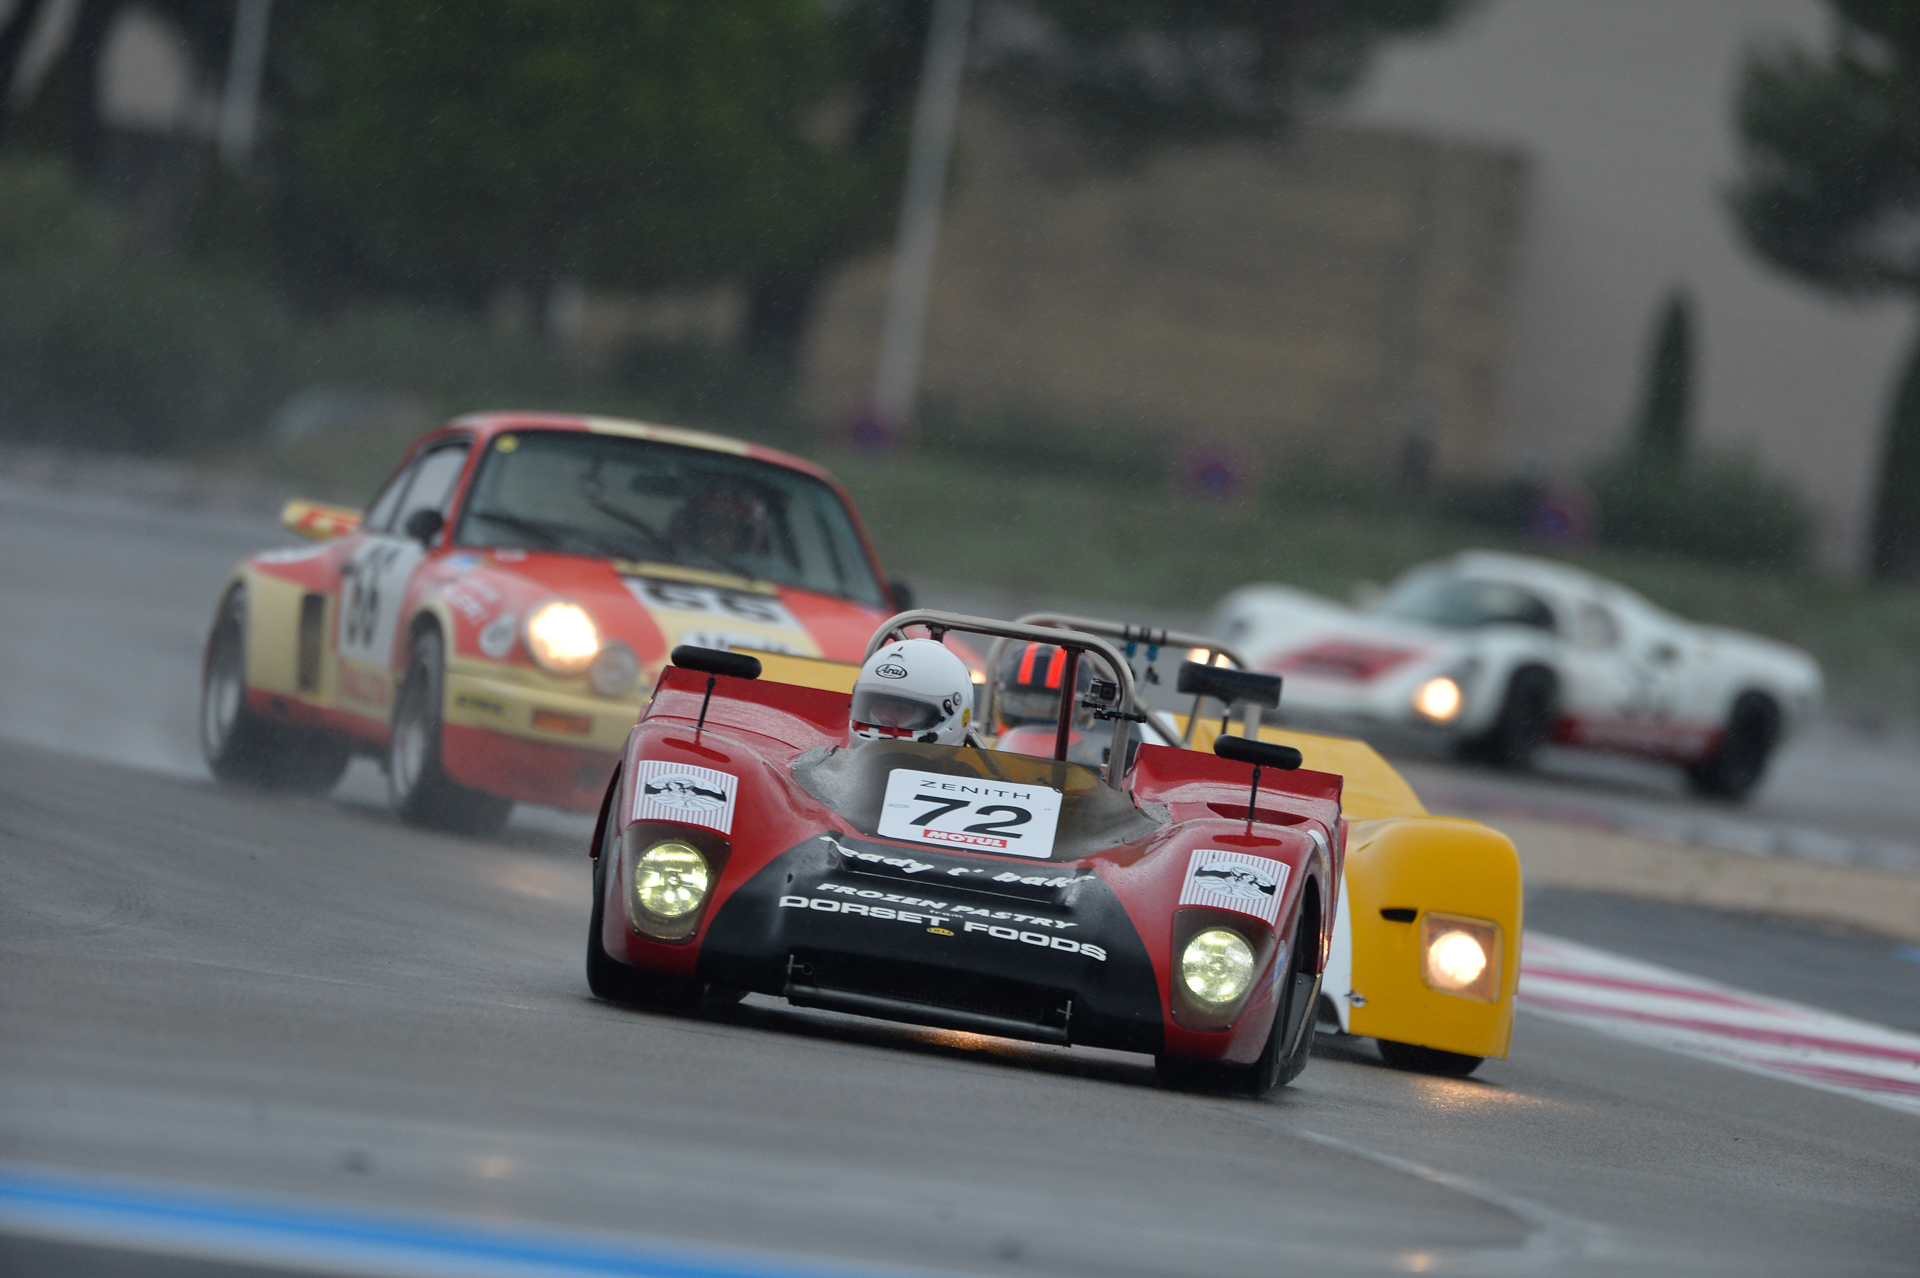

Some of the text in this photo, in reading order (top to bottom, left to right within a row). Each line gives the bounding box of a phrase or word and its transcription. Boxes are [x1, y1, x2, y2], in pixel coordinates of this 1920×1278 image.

[920, 779, 1031, 800] ZENITH
[909, 794, 1032, 839] 72
[925, 830, 1004, 848] MOTUL
[779, 896, 1107, 961] DORSET FOODS
[816, 883, 1079, 929] FROZEN PASTRY
